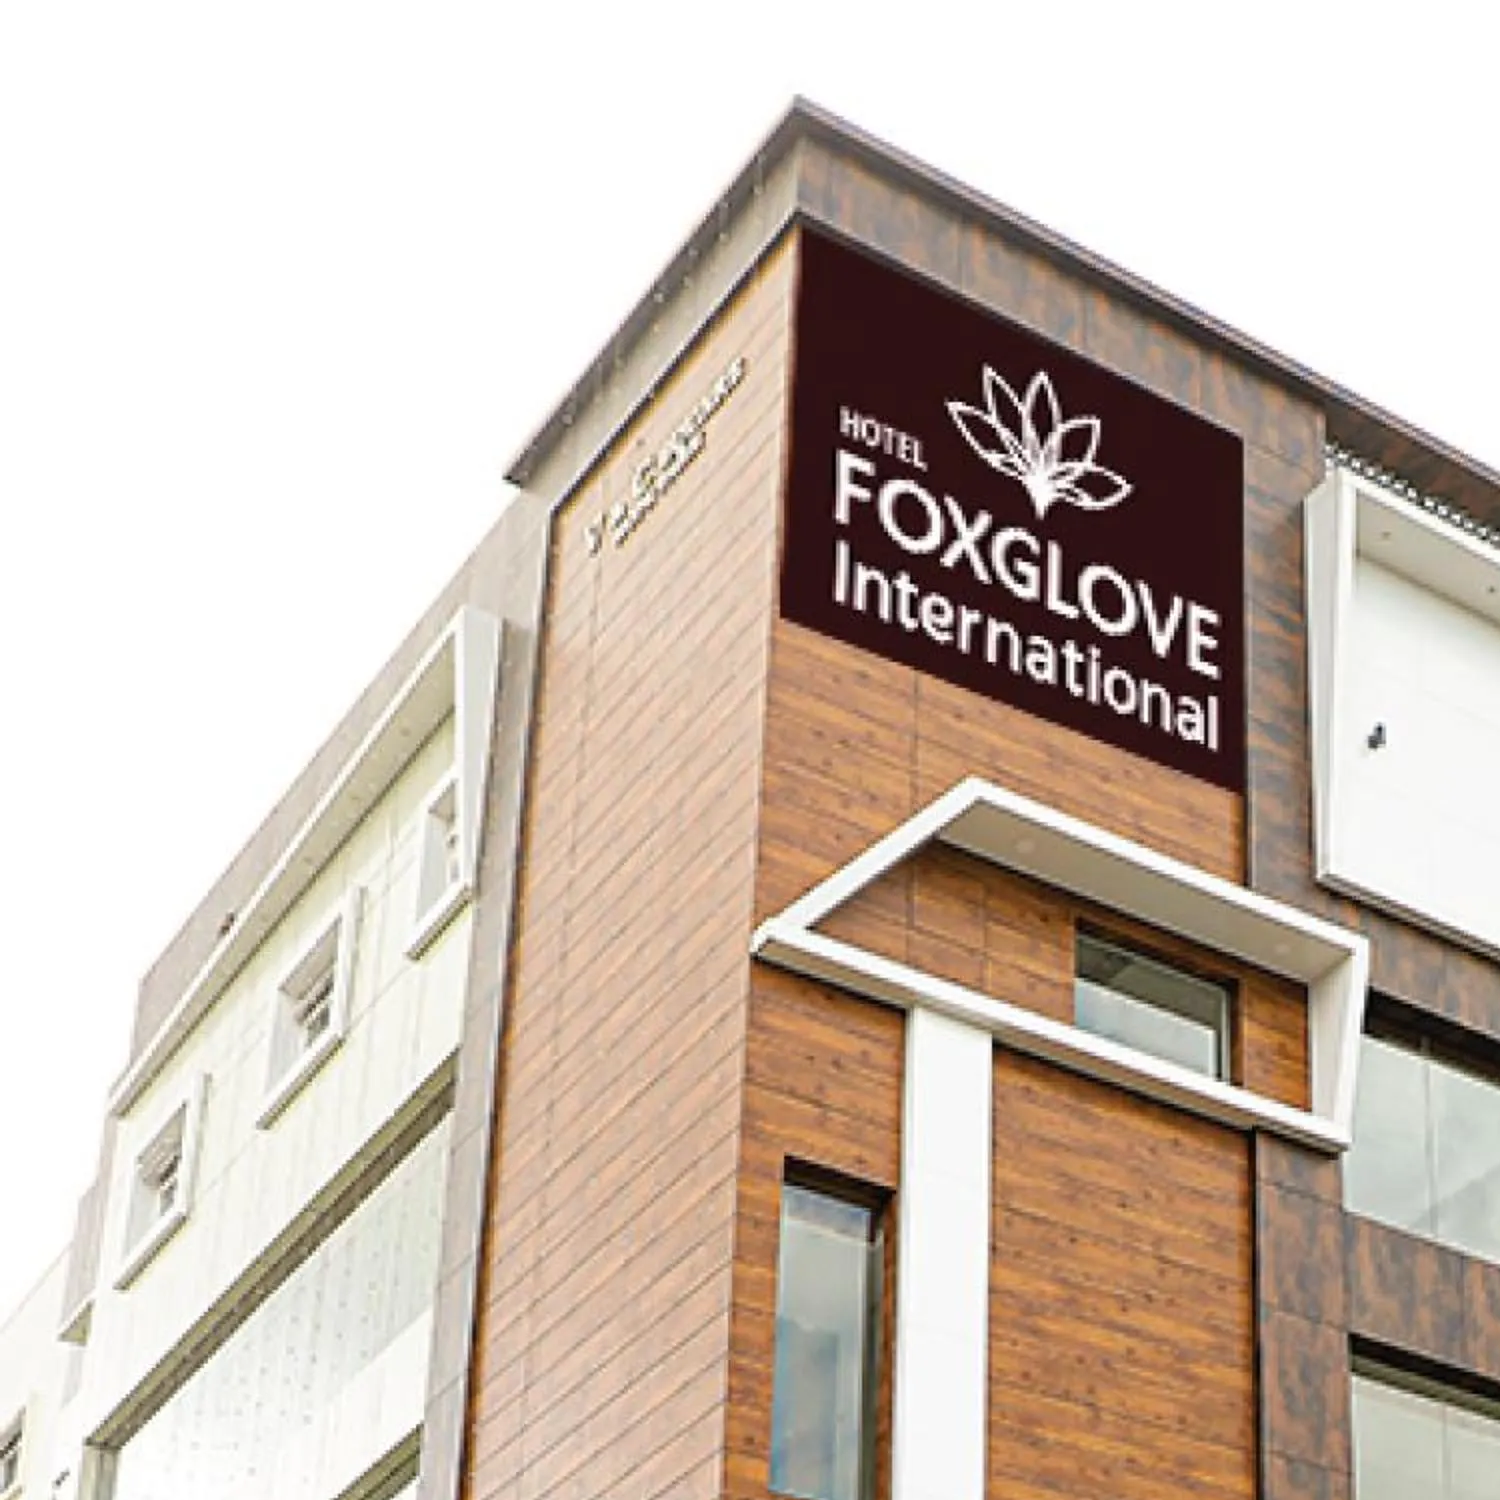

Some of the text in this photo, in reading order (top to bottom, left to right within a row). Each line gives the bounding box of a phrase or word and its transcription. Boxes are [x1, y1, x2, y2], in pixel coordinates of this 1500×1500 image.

[839, 406, 928, 471] HOTEL
[834, 449, 1220, 680] FOXGLOVE
[834, 540, 1219, 753] International
